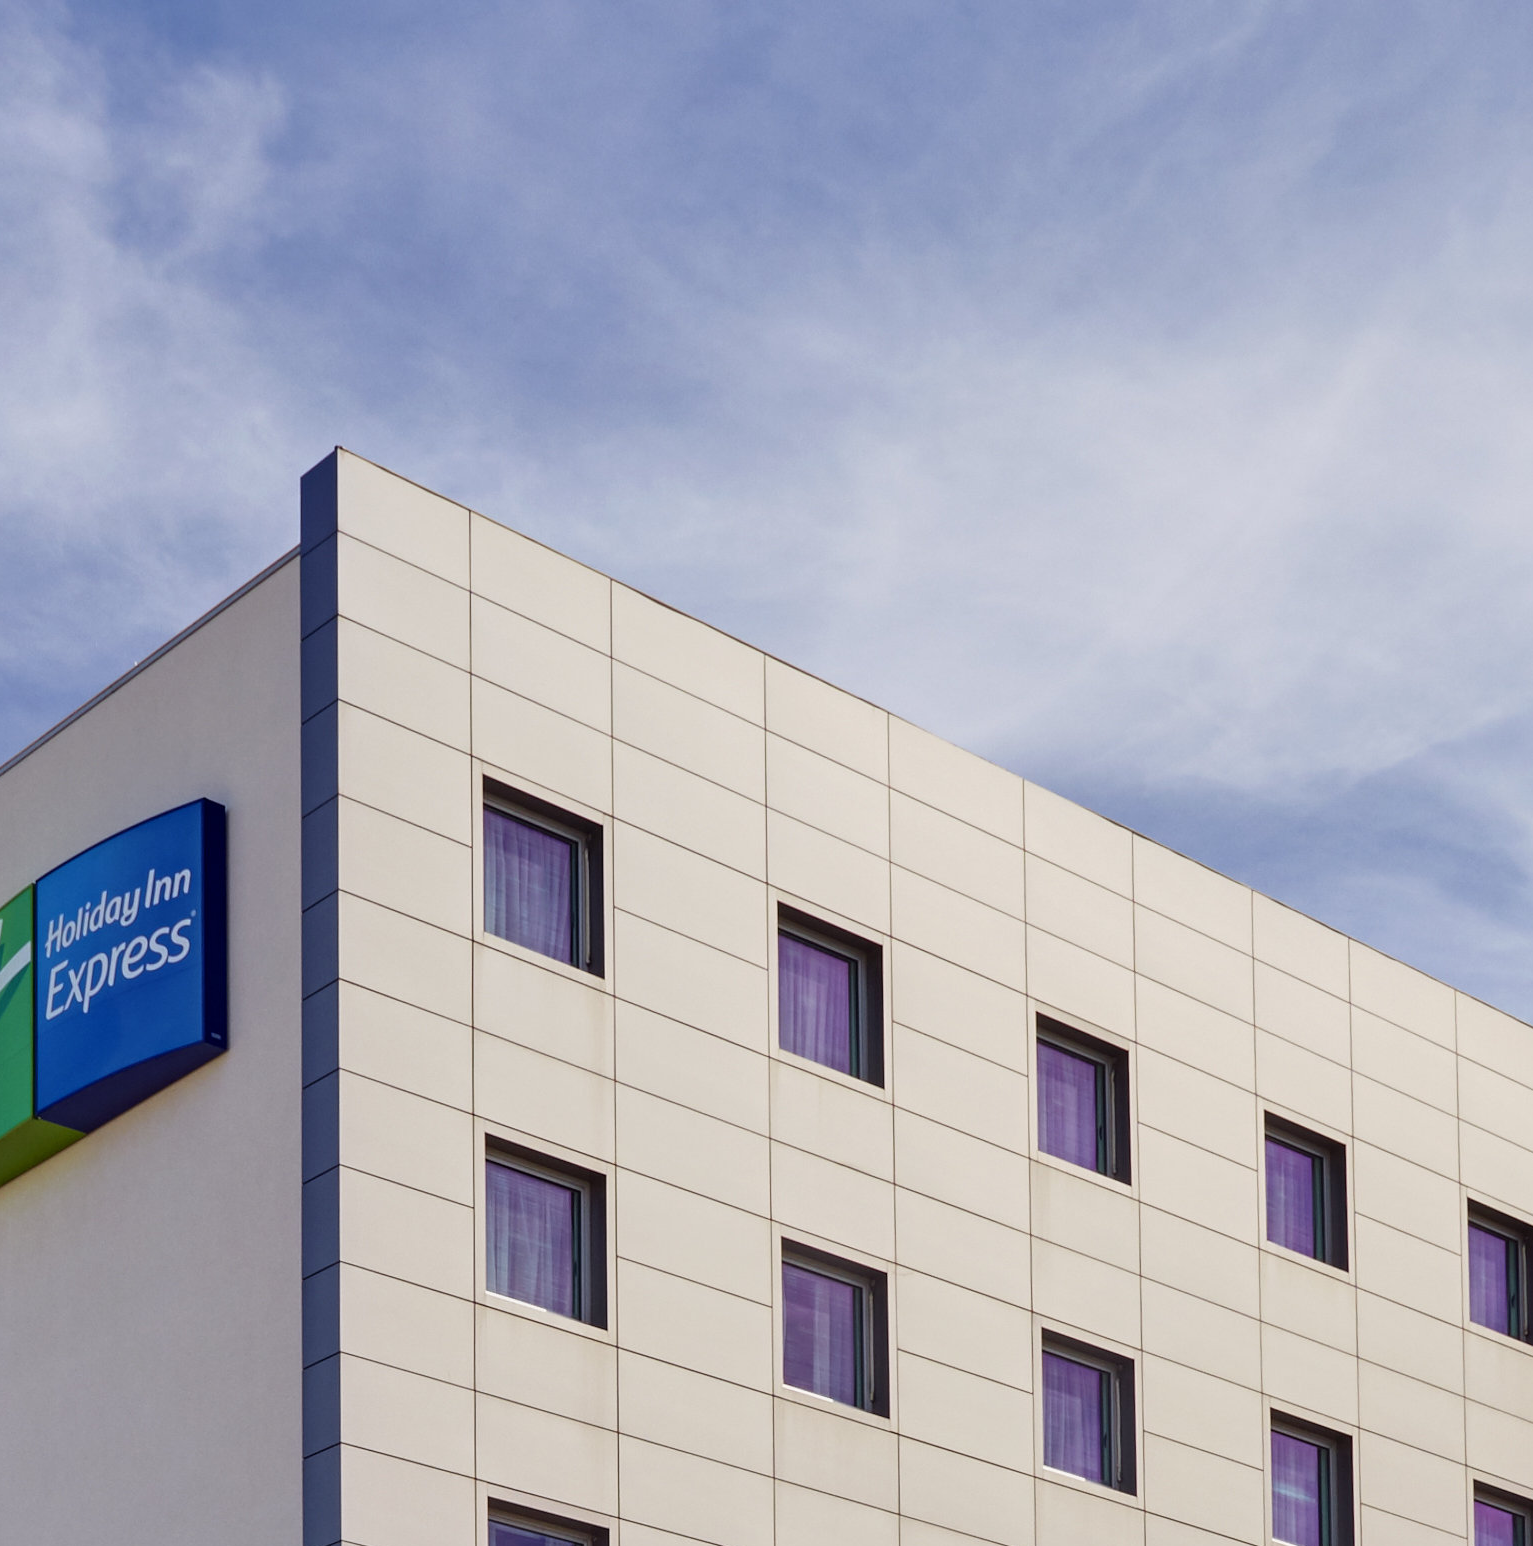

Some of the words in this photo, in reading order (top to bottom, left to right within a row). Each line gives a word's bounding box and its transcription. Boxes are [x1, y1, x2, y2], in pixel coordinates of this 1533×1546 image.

[45, 890, 141, 958] Holiday
[144, 867, 192, 909] Inn
[45, 917, 193, 1021] Express
